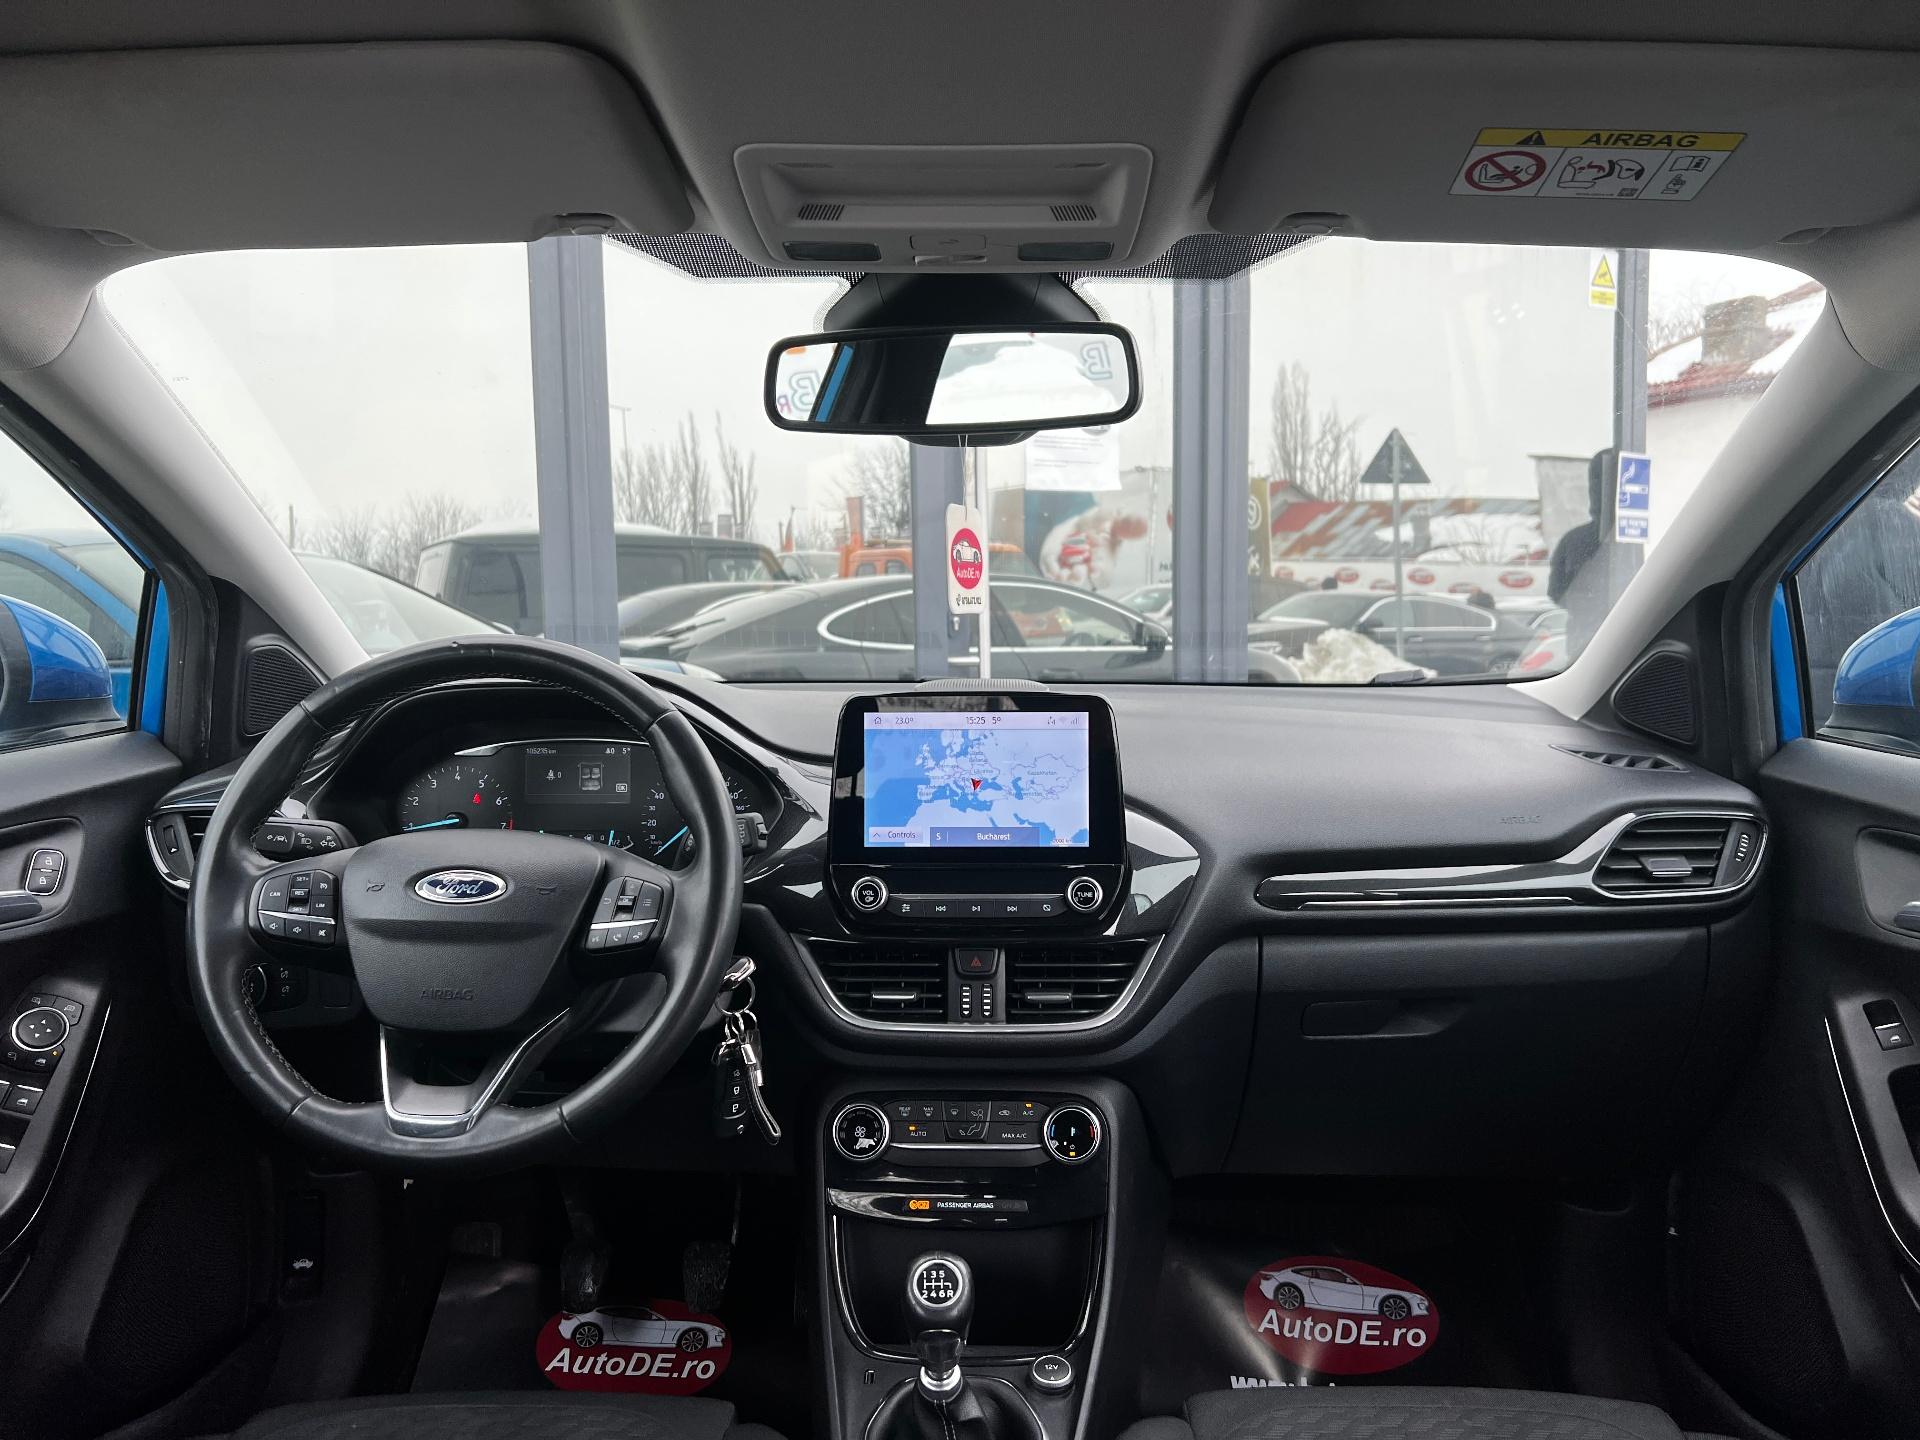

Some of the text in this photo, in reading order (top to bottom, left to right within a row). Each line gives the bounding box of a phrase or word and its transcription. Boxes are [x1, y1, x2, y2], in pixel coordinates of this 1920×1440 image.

[1581, 133, 1700, 148] AIRBAG
[966, 716, 986, 724] 15:25
[454, 772, 460, 780] 4
[432, 780, 437, 788] 3
[478, 780, 484, 788] 5
[412, 797, 419, 806] 2
[496, 797, 502, 805] 6
[436, 876, 484, 894] Ford
[420, 988, 474, 1000] AIRBAG
[922, 1290, 928, 1298] 2
[1258, 1308, 1427, 1348] AutoDE.ro
[545, 1348, 716, 1380] AutoDE.ro
